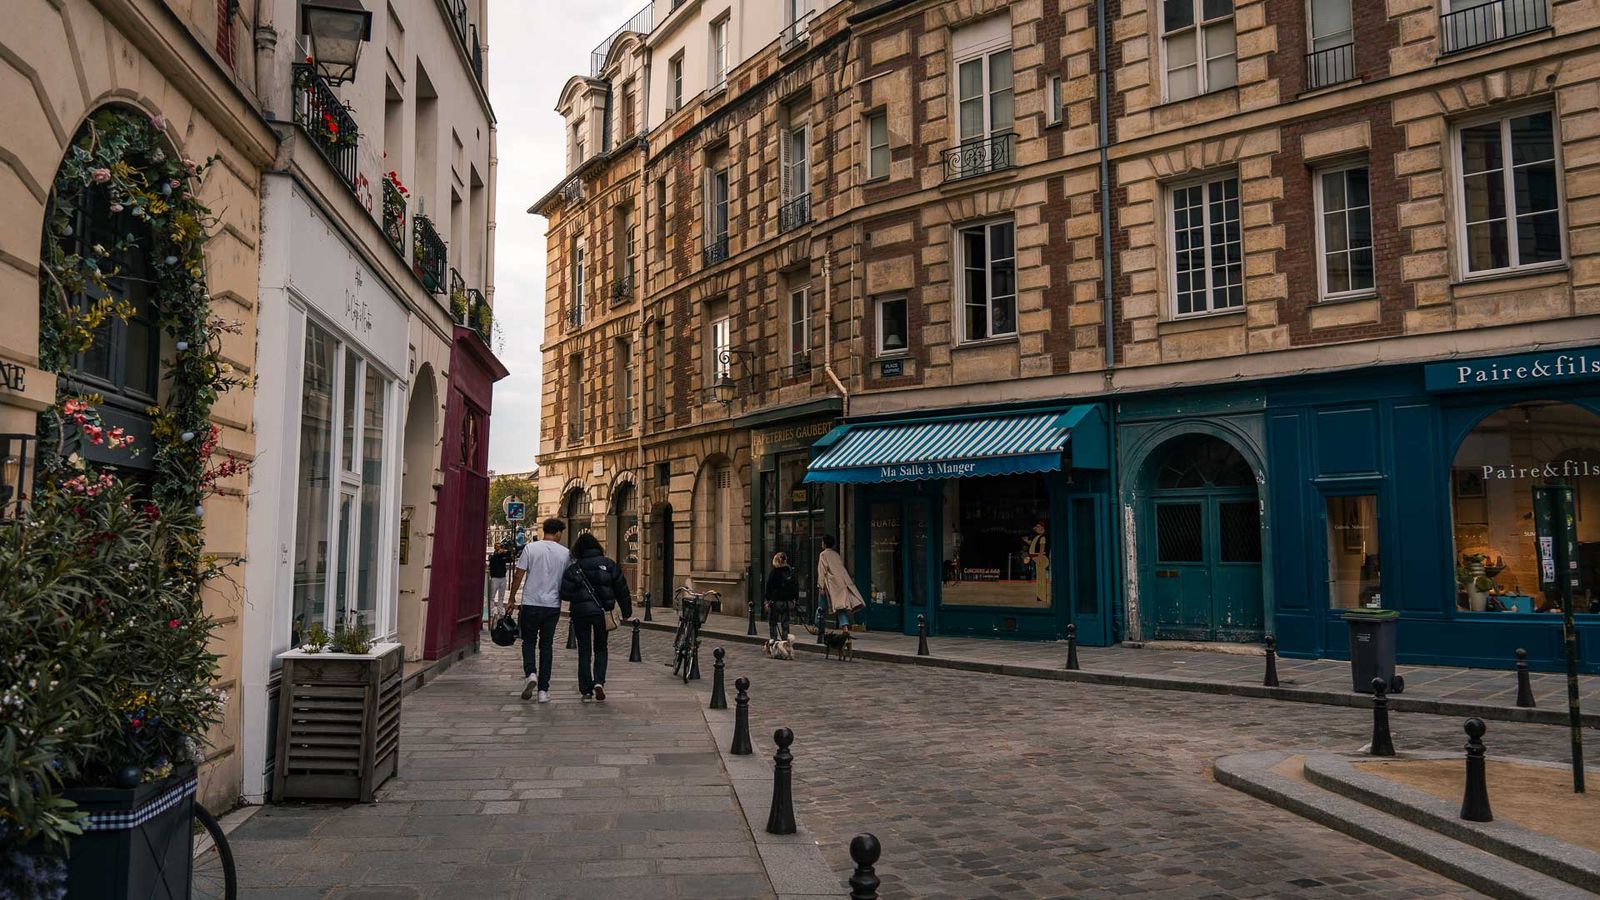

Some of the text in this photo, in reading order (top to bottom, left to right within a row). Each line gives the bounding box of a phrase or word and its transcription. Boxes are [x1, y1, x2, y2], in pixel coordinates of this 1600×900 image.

[753, 422, 832, 446] PAPETERIES GAUBERT
[880, 462, 975, 478] Ma Salle à Manger
